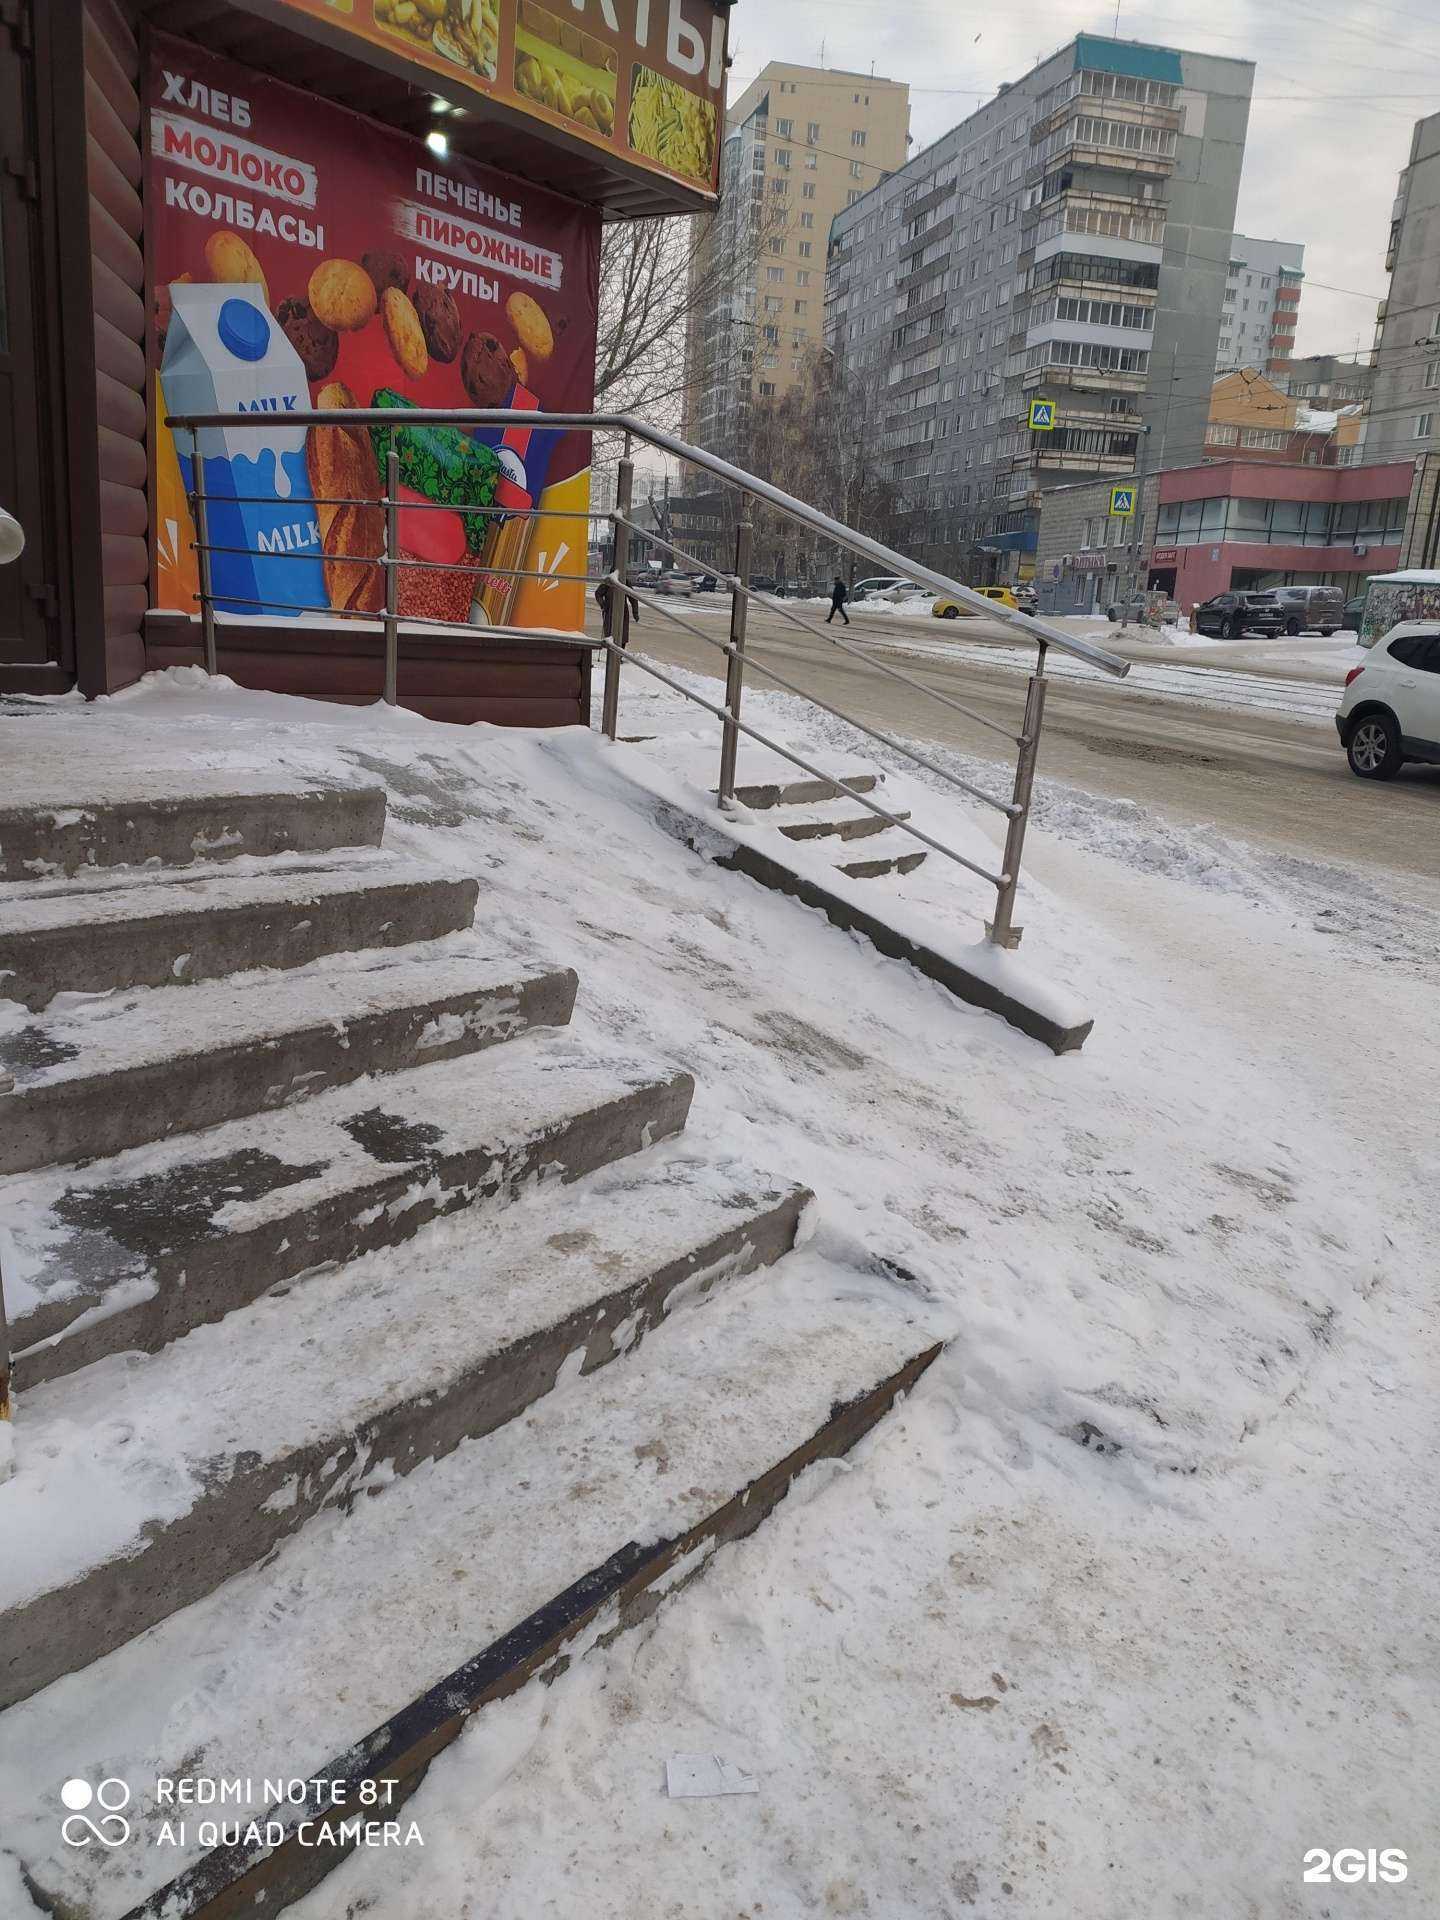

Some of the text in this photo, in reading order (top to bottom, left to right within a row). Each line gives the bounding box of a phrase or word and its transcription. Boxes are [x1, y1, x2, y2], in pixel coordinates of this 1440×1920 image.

[161, 70, 252, 128] ХЛЕБ
[163, 124, 306, 196] МОЛОКО
[165, 176, 325, 251] КОЛБАСЫ
[416, 167, 522, 228] ПЕЧЕНЬЕ
[415, 210, 553, 280] ПИРОЖНЫЕ
[415, 255, 499, 304] КРУПЫ
[257, 520, 320, 553] MILK
